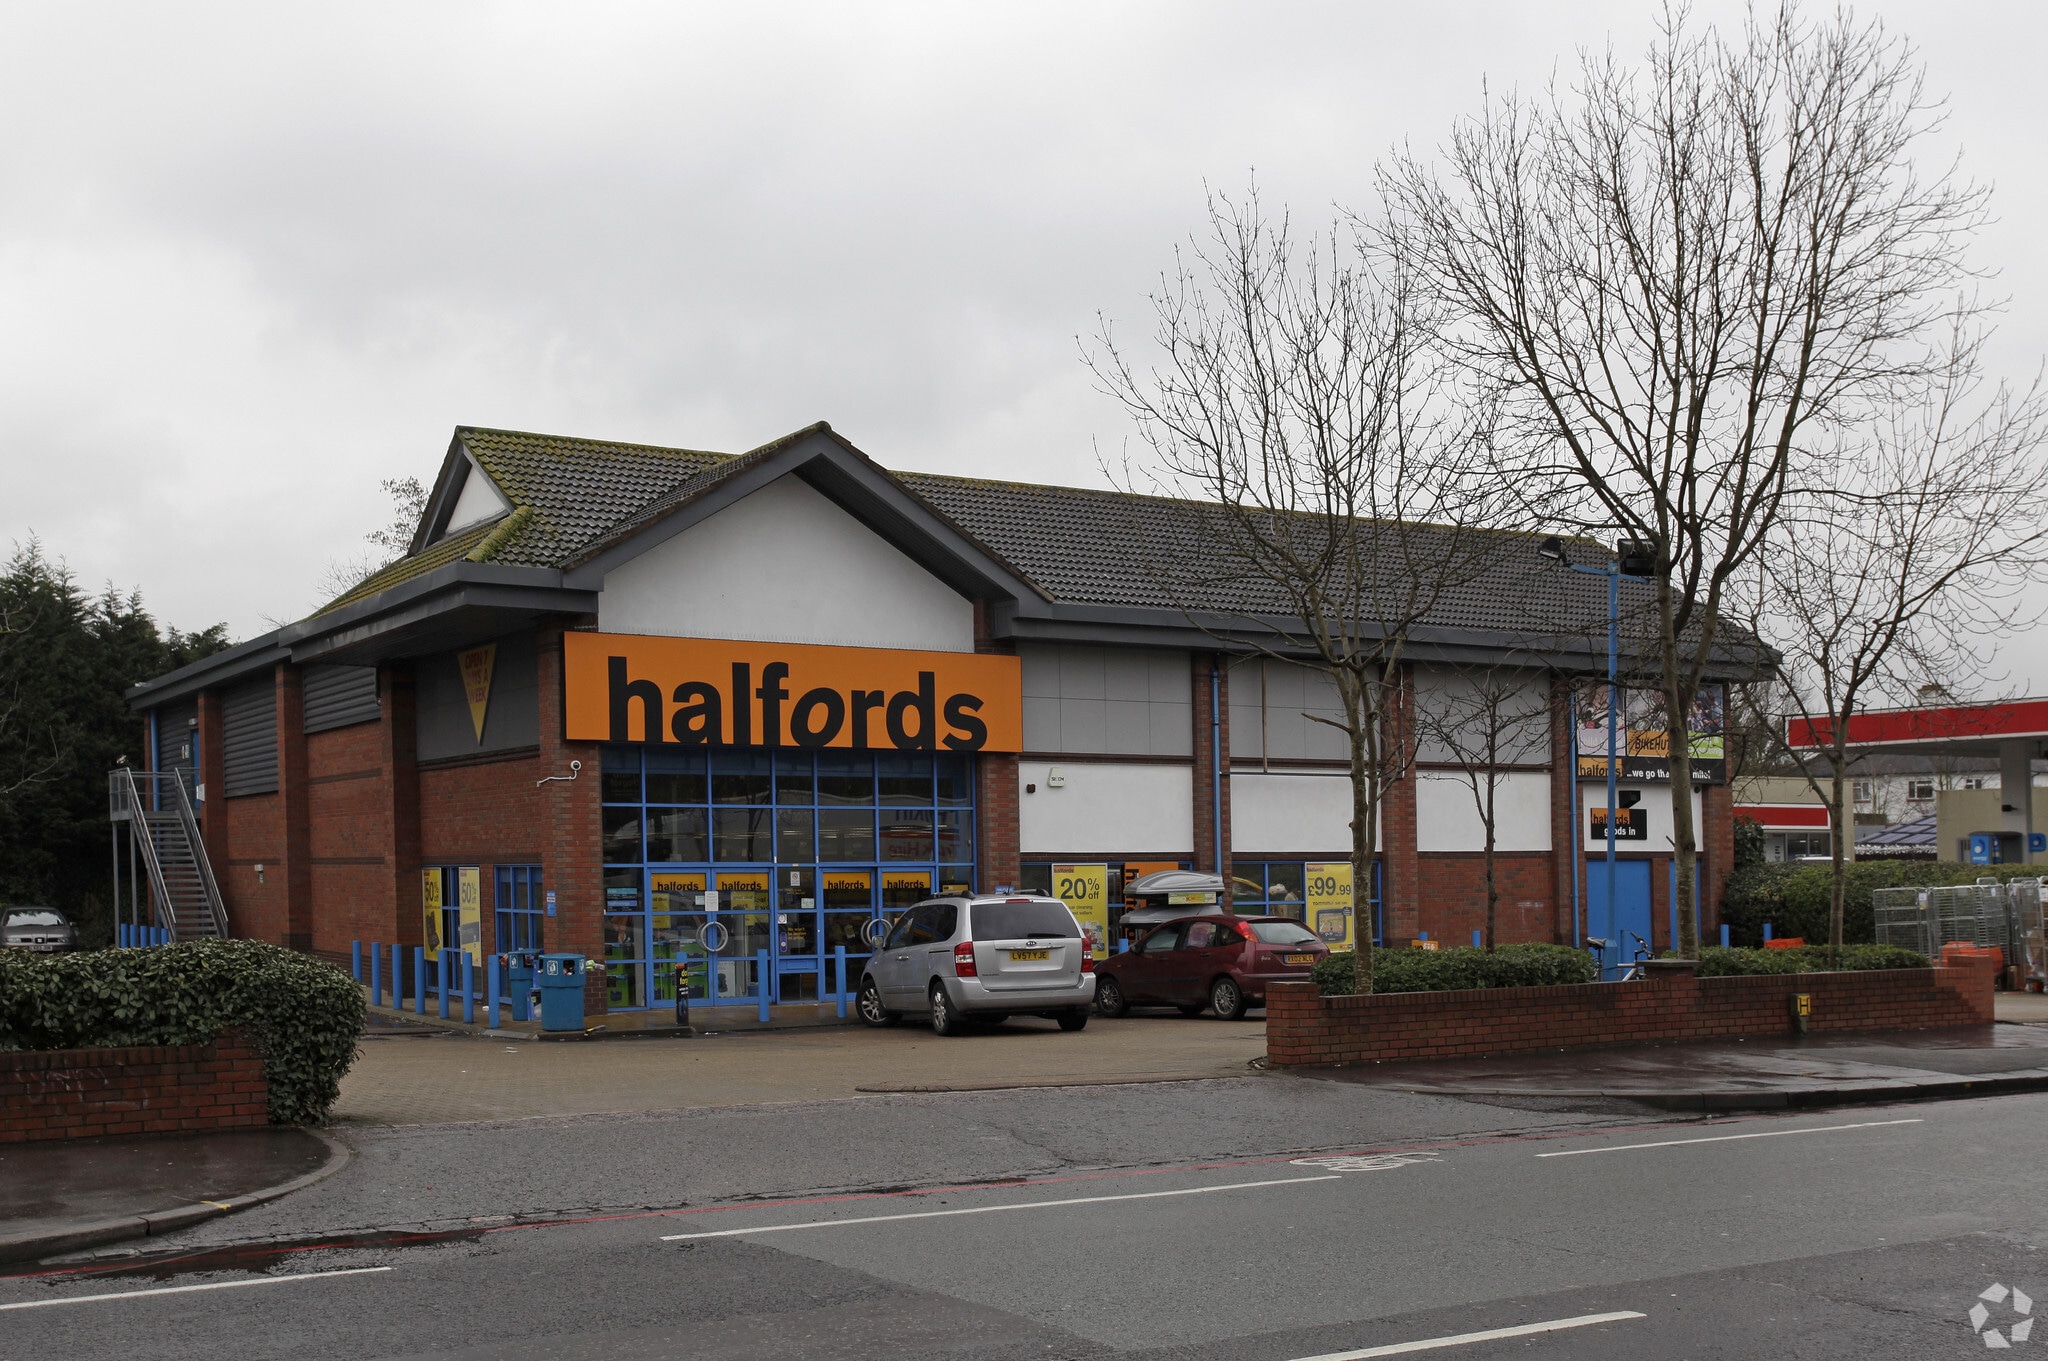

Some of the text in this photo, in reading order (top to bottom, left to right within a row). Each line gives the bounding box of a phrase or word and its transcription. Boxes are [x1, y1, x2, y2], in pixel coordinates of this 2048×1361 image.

[465, 651, 482, 669] OPEN
[470, 687, 486, 704] WEEK
[608, 656, 988, 752] halfords
[1580, 765, 1620, 777] halfos
[1646, 770, 1655, 780] go
[1593, 813, 1628, 825] halrds
[1604, 826, 1636, 837] gods in
[657, 881, 699, 891] halfords
[721, 881, 762, 891] halfords
[828, 880, 865, 889] halfords
[887, 880, 924, 889] halfords
[1308, 876, 1352, 897] £99.99
[1088, 891, 1099, 900] off
[1012, 952, 1047, 960] LV57 YJE
[1799, 997, 1809, 1013] H
